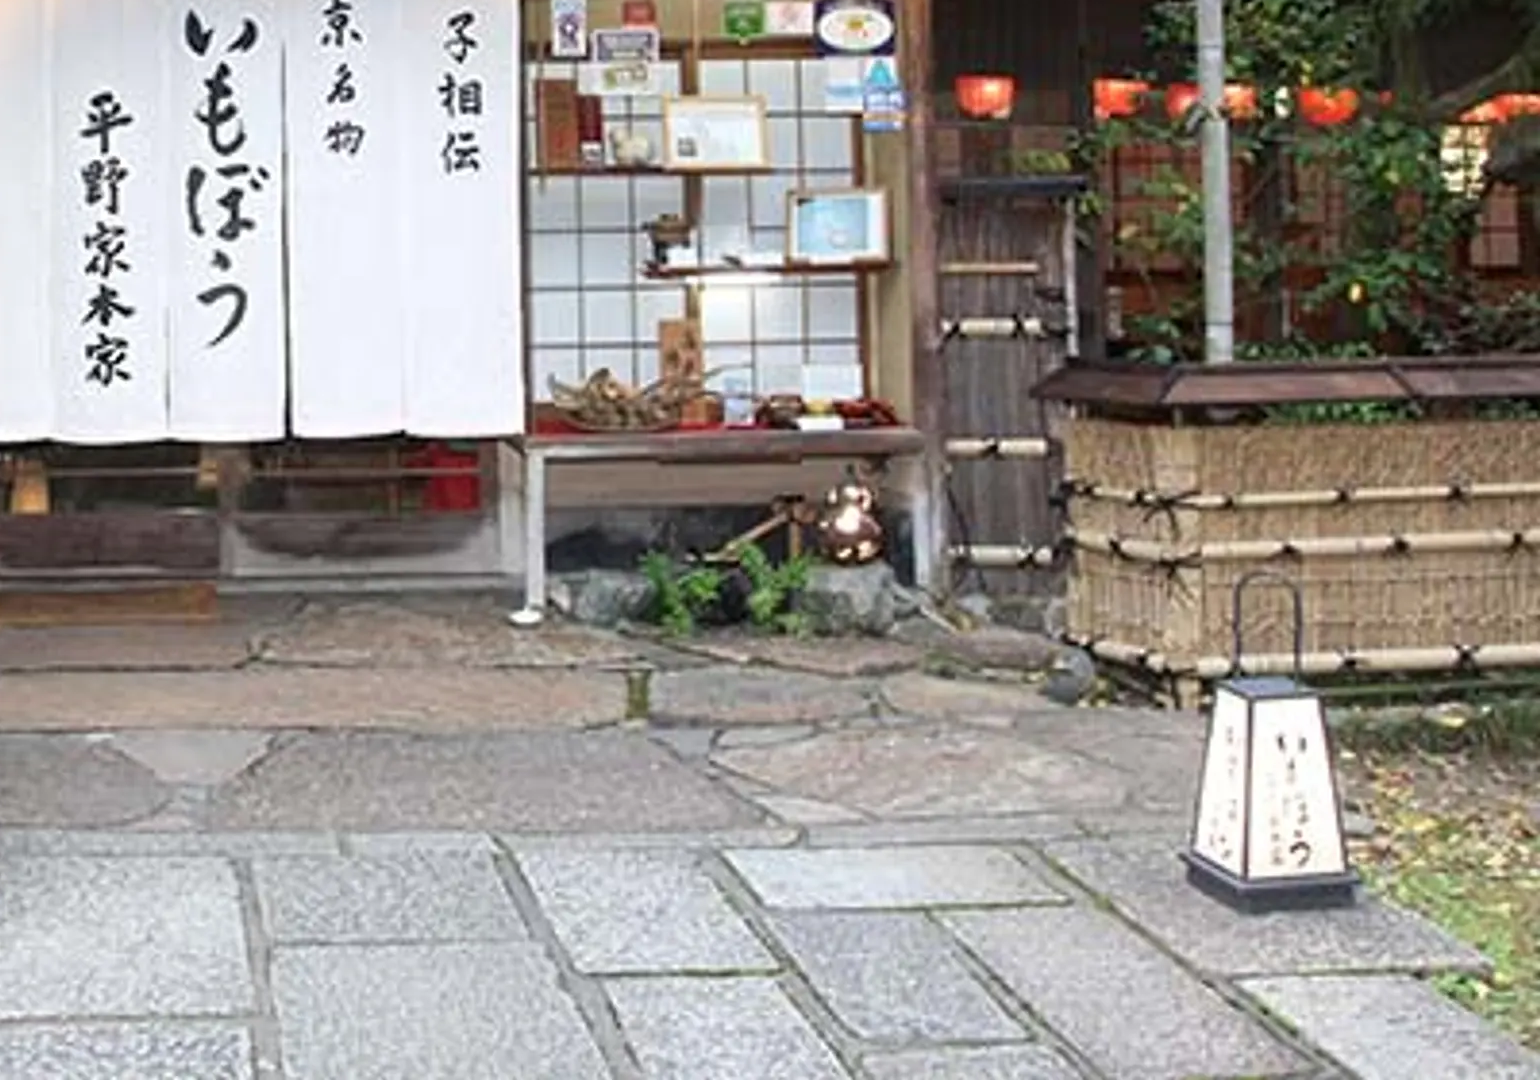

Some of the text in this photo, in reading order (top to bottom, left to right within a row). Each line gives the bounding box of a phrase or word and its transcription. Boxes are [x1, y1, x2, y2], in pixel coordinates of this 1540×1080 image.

[79, 90, 136, 388] 平野家本家
[183, 8, 270, 347] いもぼう
